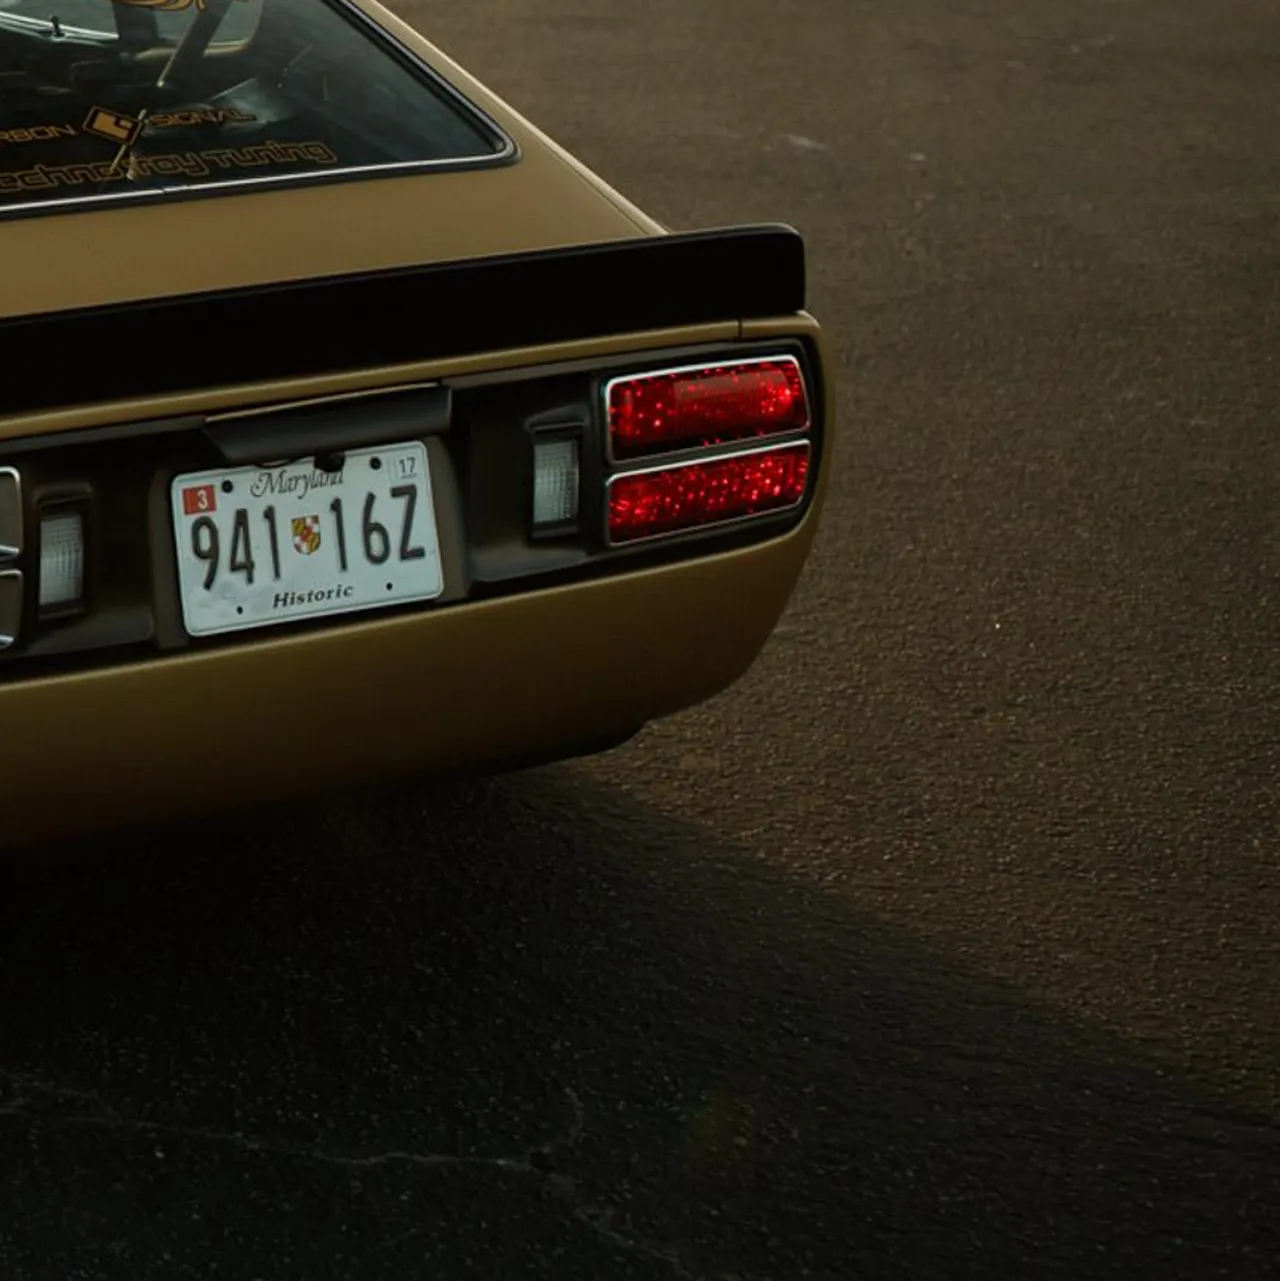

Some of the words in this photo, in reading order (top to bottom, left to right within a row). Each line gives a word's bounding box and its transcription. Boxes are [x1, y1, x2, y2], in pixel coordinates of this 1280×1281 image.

[150, 106, 258, 128] SIGNAL
[399, 456, 416, 473] 17
[250, 469, 344, 500] Maryland
[197, 488, 209, 510] 3
[191, 504, 282, 591] 941
[330, 483, 426, 572] 16Z
[273, 583, 354, 609] Historic
